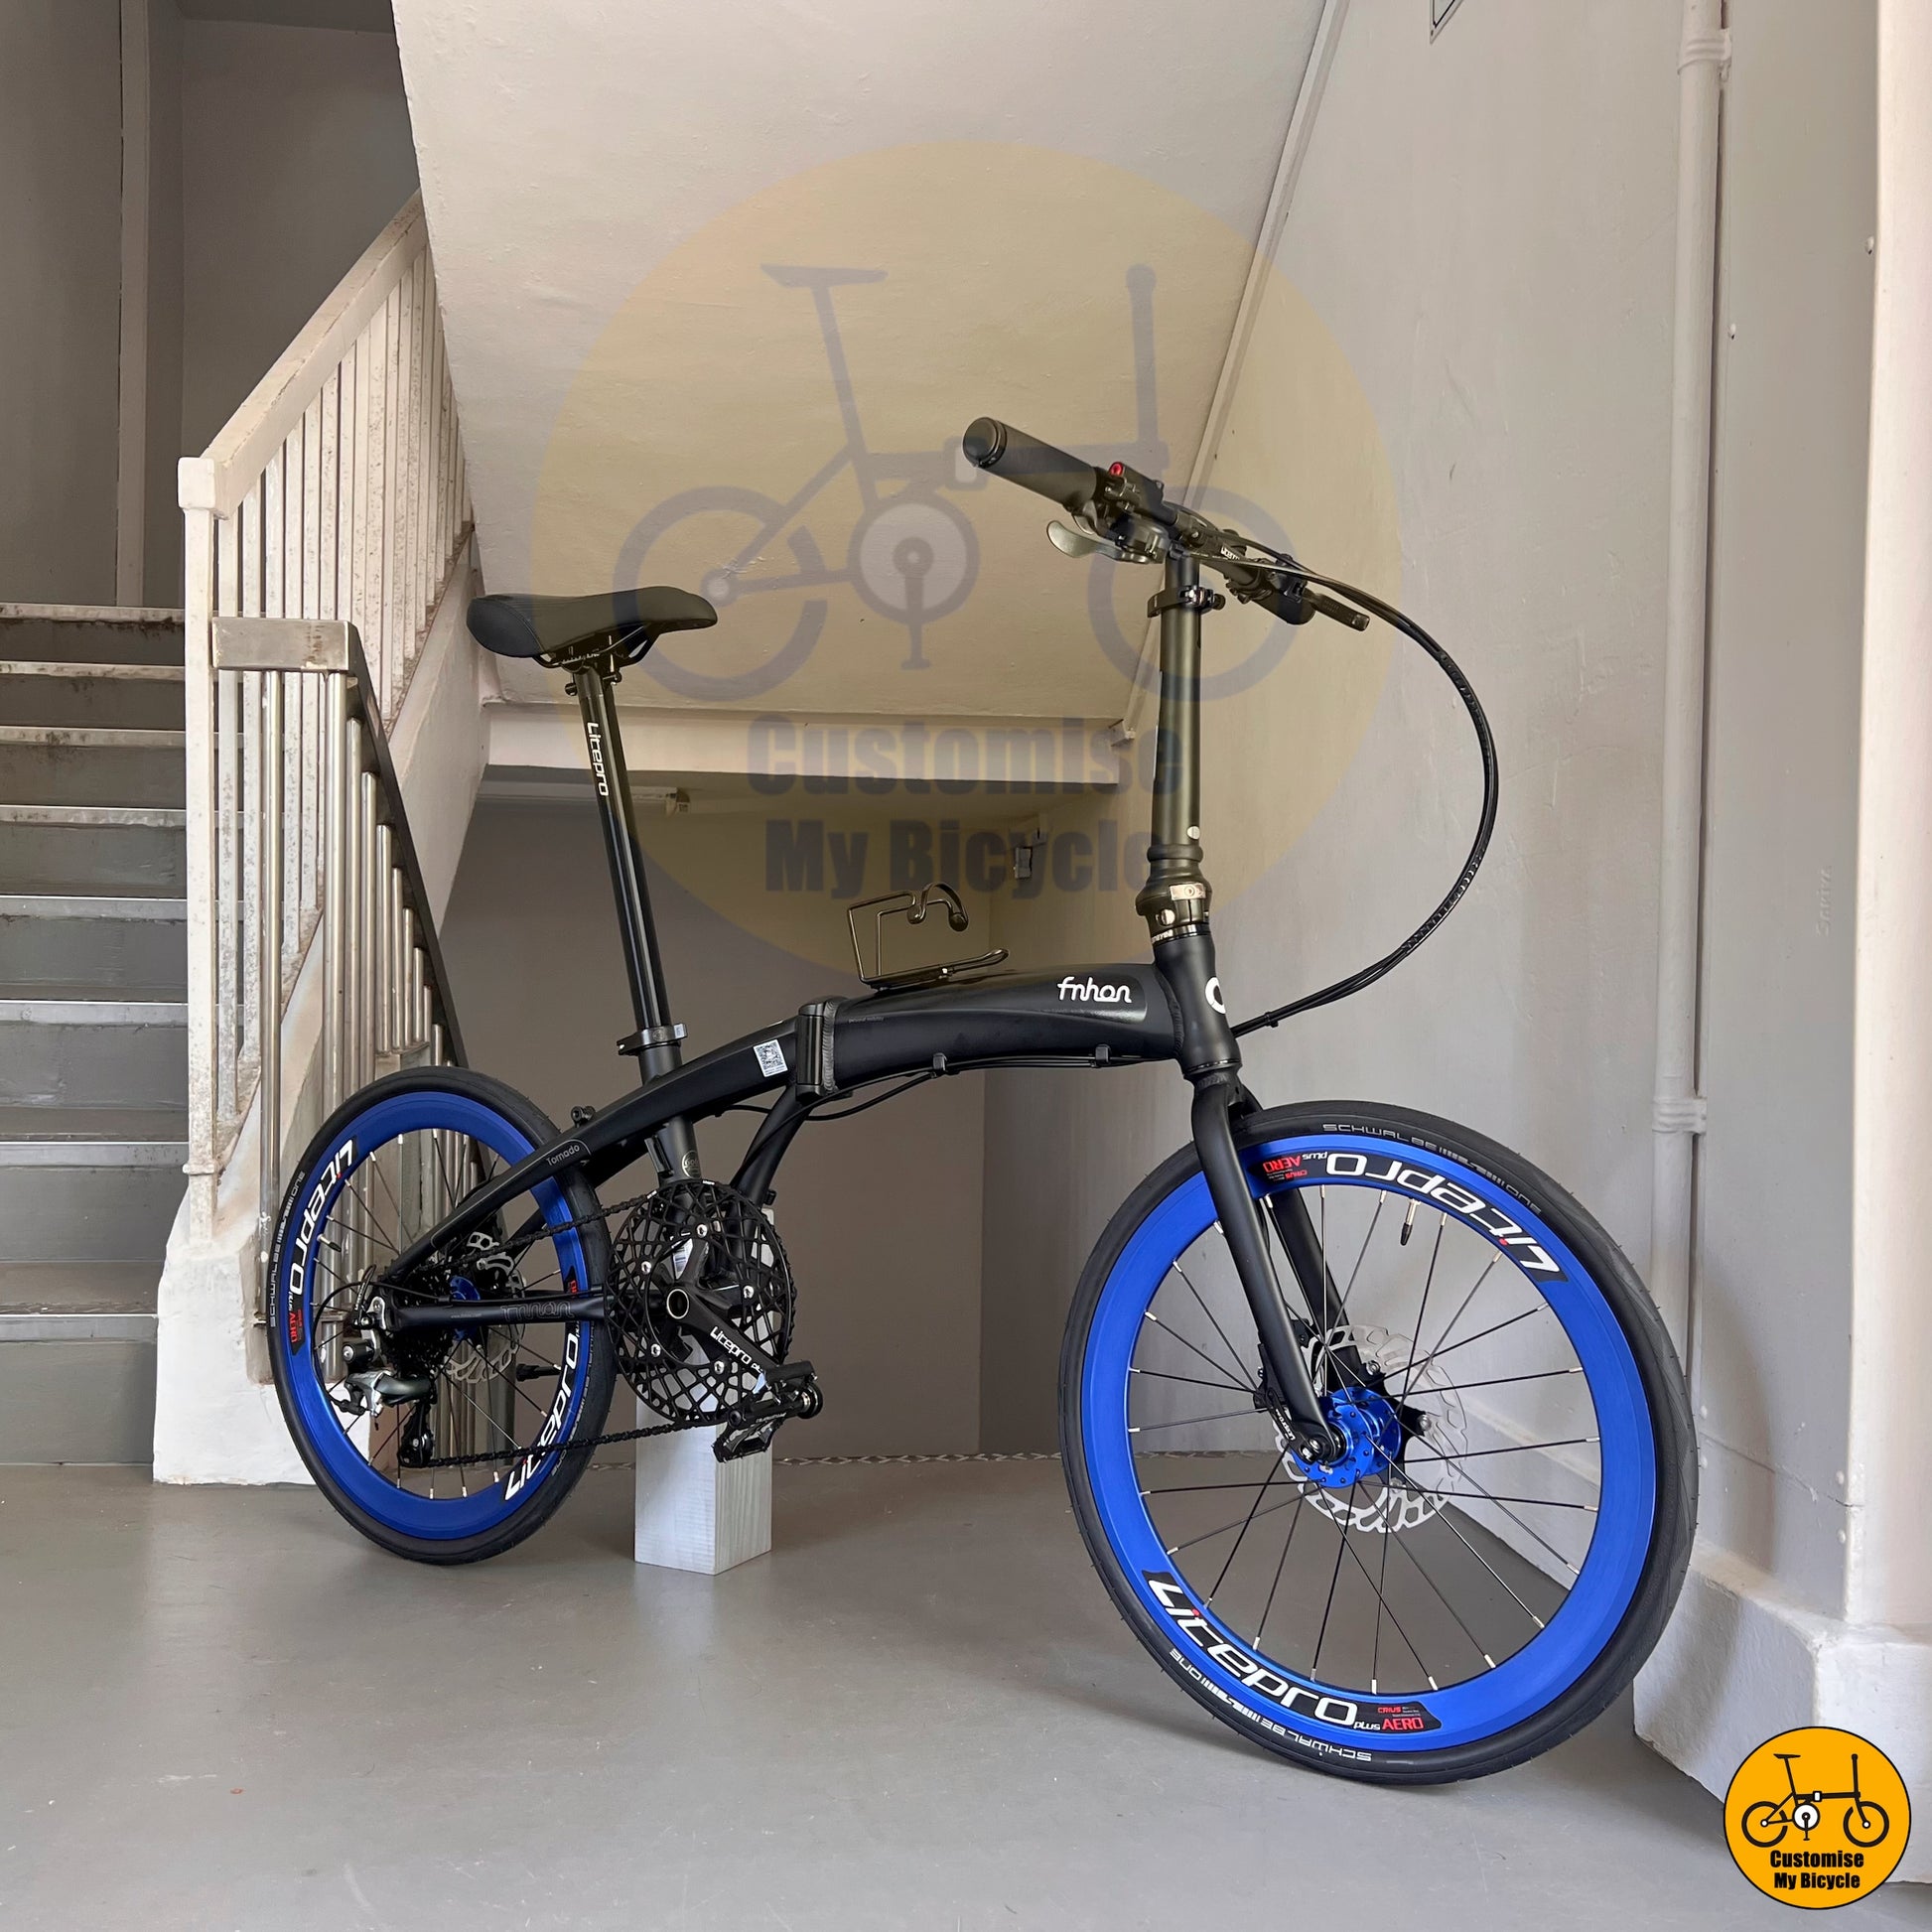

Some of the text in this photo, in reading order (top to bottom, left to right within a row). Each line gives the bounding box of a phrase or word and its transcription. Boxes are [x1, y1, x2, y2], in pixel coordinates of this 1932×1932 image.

[587, 722, 609, 796] Litepro
[1057, 977, 1132, 1004] fnhon
[546, 1145, 580, 1167] Tornado
[1322, 1124, 1438, 1152] SCHWALBE
[1263, 1155, 1302, 1173] AERO
[290, 1139, 353, 1296] Litepro
[1326, 1154, 1560, 1272] Litepro
[710, 1325, 752, 1365] Litepro
[1148, 1580, 1381, 1730] Litepro plus
[1261, 1719, 1372, 1762] SCHWALBE
[1382, 1717, 1425, 1730] AERO
